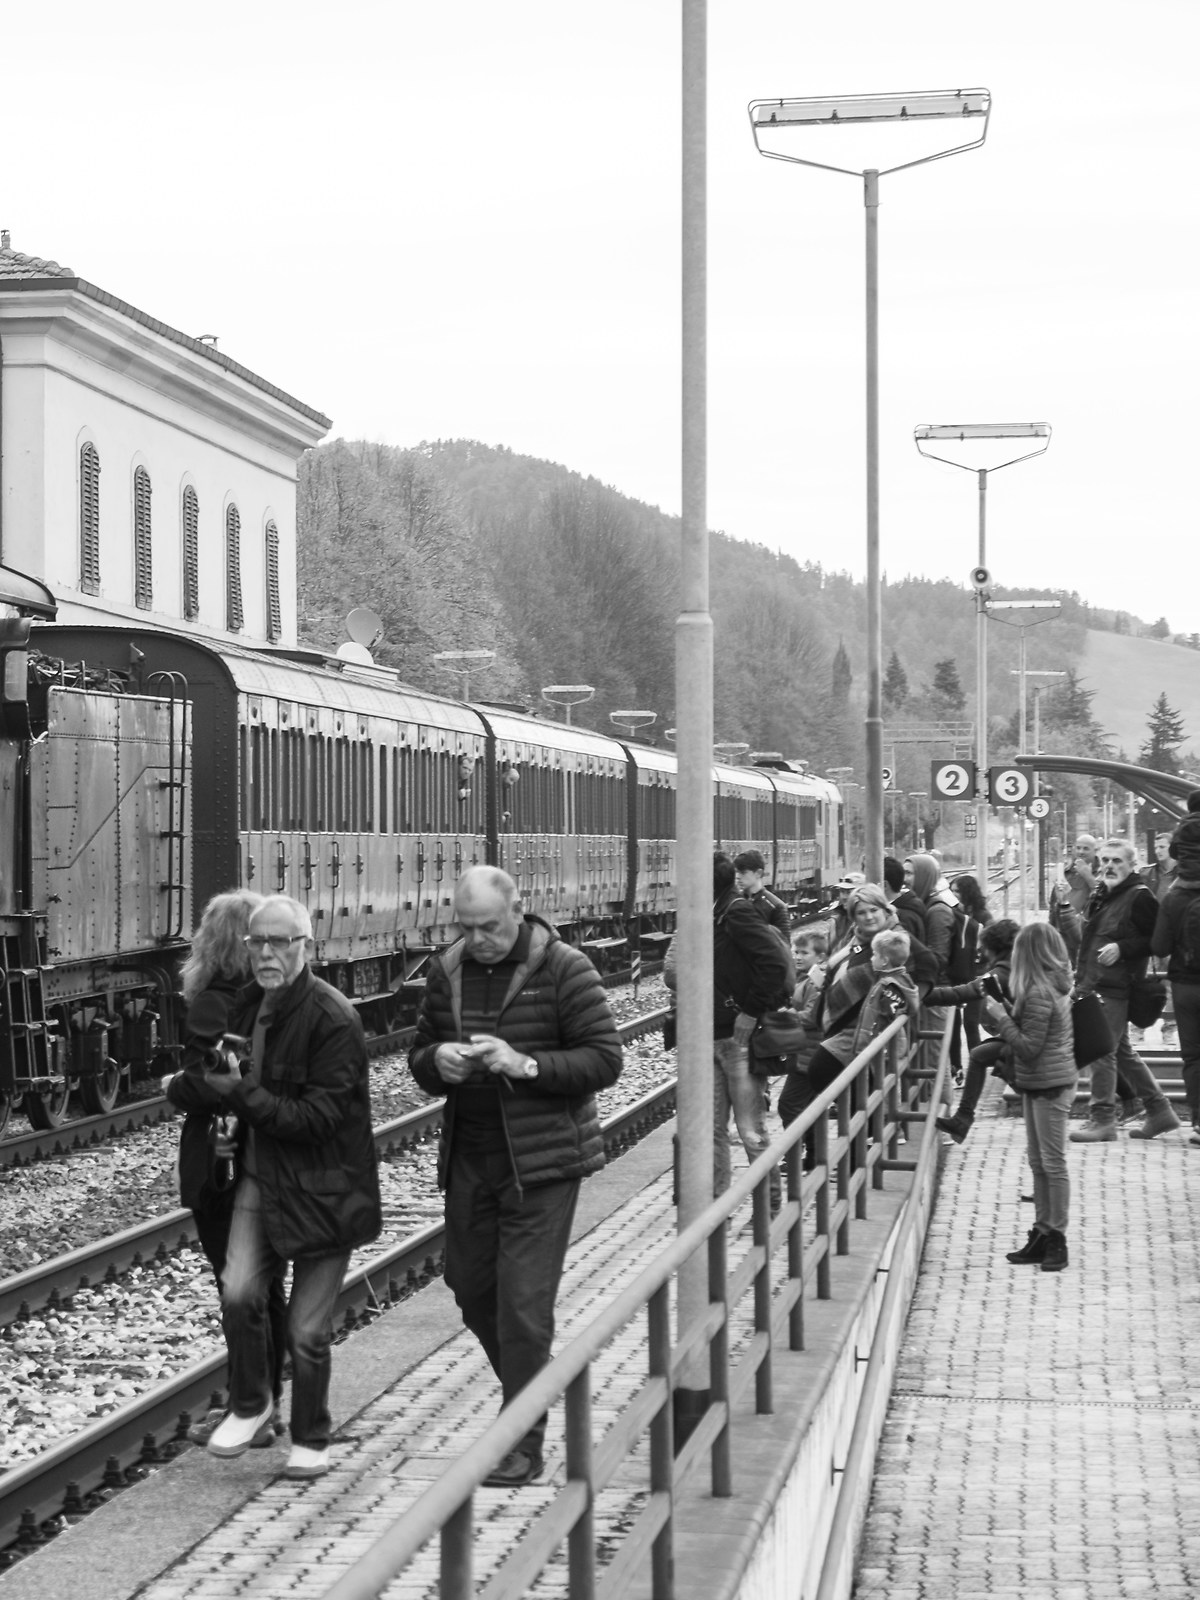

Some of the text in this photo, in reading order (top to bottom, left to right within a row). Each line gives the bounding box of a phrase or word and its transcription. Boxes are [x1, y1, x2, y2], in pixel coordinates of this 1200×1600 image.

[944, 770, 960, 790] 2
[1004, 776, 1020, 796] 3
[1036, 803, 1044, 813] 3
